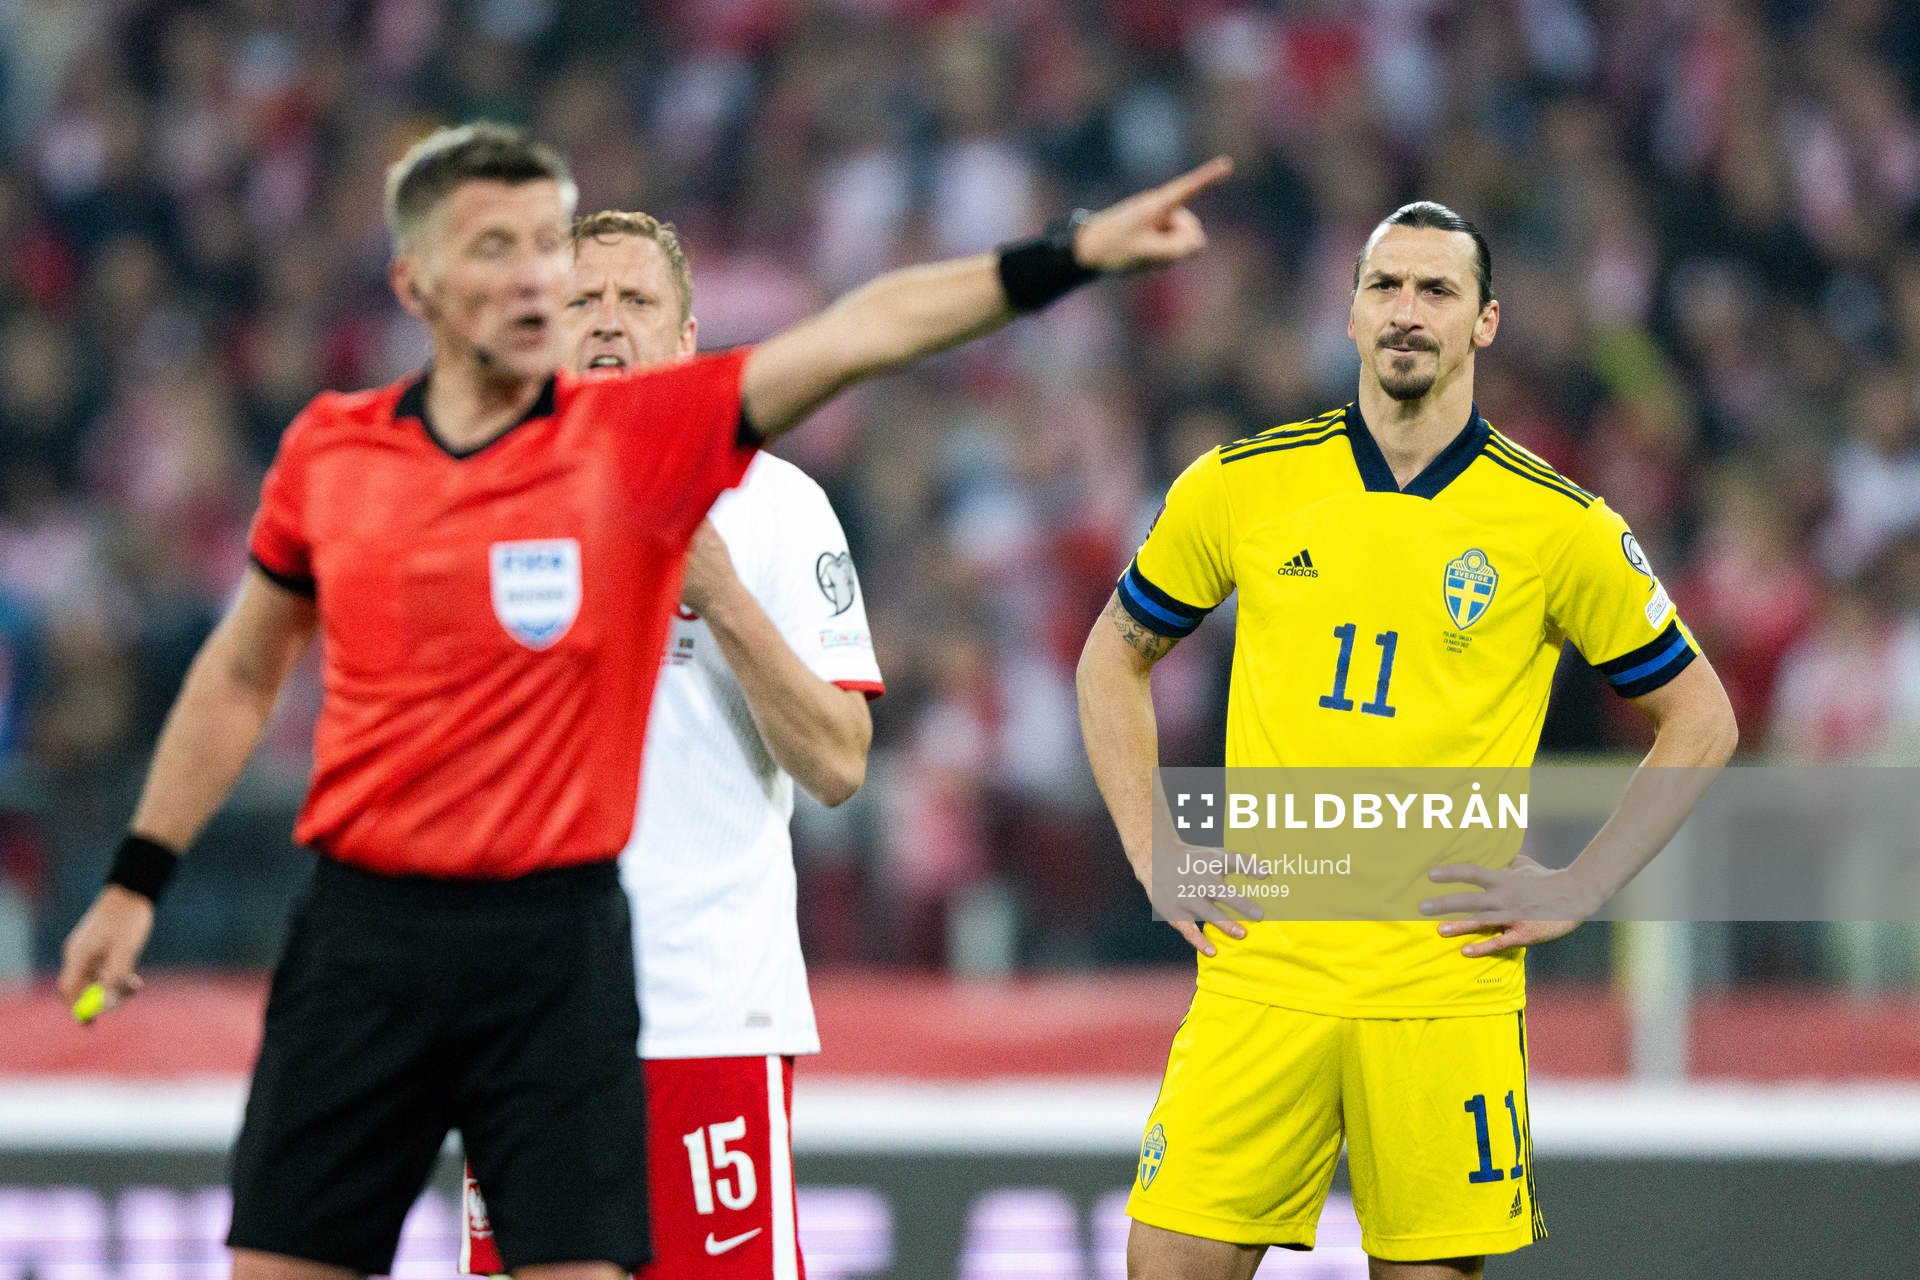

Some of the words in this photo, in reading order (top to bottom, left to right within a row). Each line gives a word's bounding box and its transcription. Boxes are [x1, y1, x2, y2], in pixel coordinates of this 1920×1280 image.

[1277, 567, 1319, 578] adidas
[1454, 570, 1489, 583] SVERIGE
[1319, 623, 1398, 718] 11
[682, 1115, 758, 1215] 15
[1464, 1090, 1524, 1184] 11
